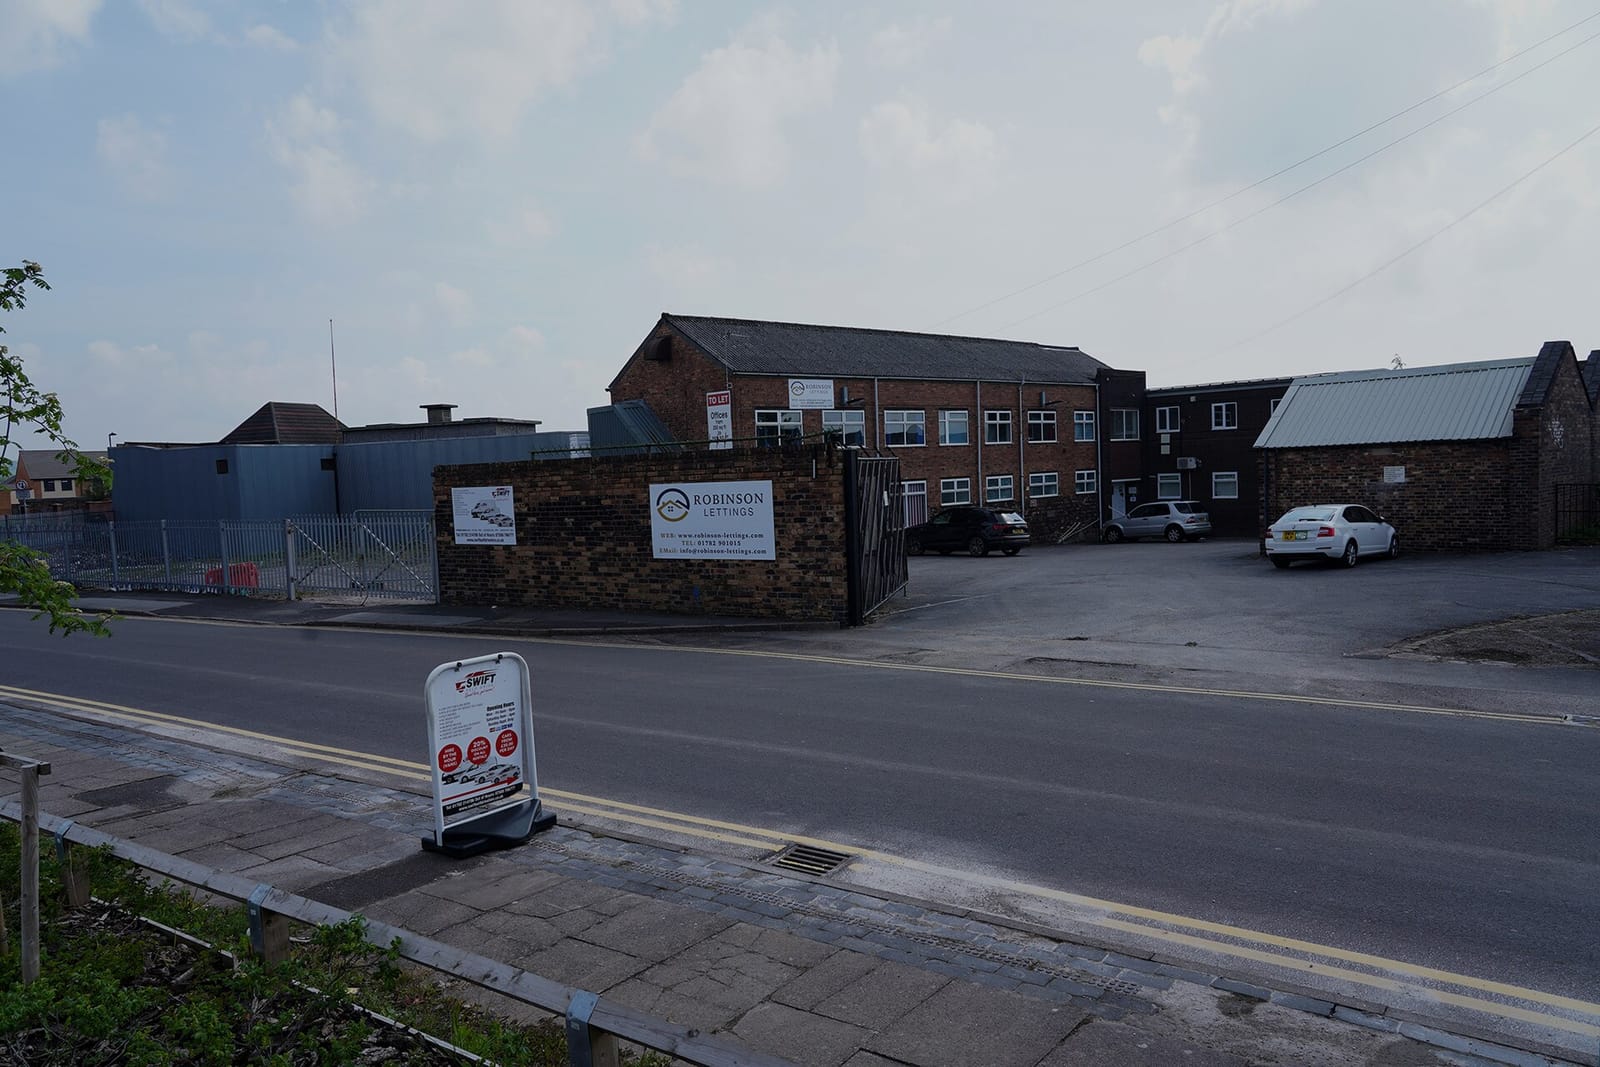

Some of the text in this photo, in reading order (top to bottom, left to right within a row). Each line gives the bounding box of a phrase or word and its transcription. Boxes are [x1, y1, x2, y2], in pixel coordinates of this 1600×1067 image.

[708, 394, 728, 405] TO LET
[694, 493, 764, 506] ROBINSON
[704, 508, 754, 516] LETTINGS
[678, 532, 764, 540] www.robinson-lettings.com
[466, 673, 496, 688] SWIFT
